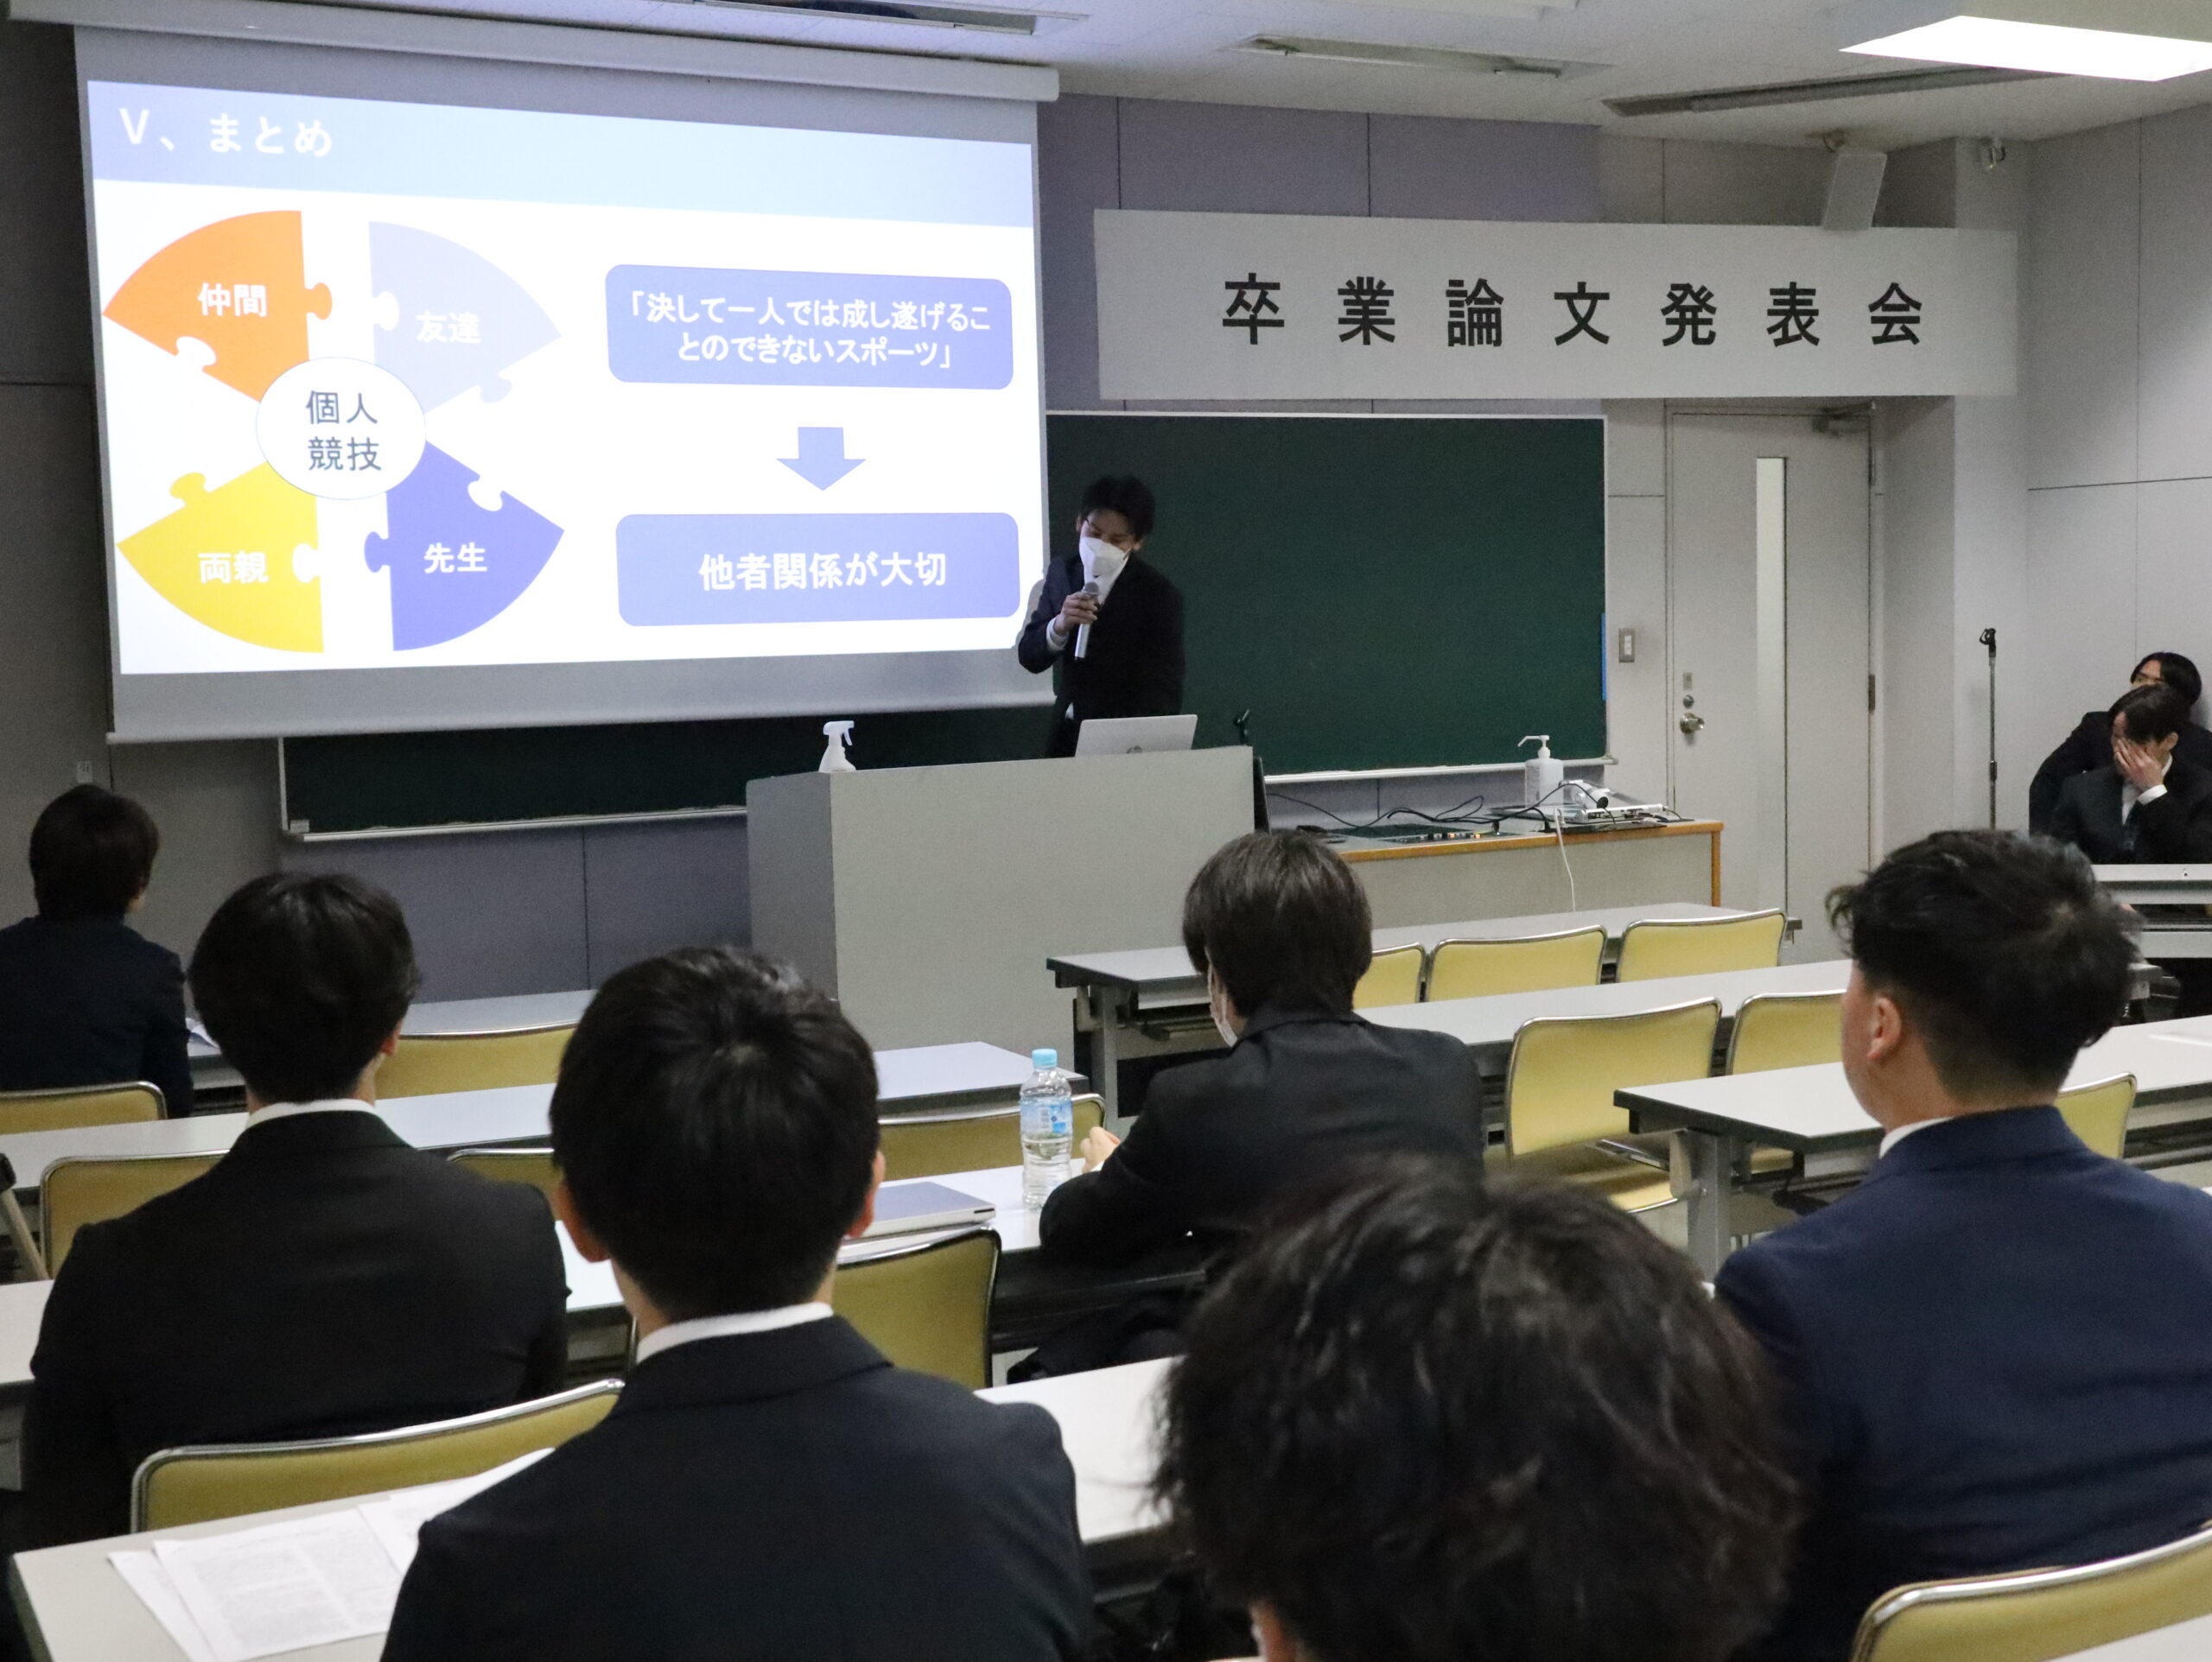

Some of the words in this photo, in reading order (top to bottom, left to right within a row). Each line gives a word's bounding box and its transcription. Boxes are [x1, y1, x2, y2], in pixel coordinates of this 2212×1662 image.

[198, 282, 267, 316] 仲間
[632, 290, 991, 332] 「決して一人では成し遂げるこ
[1222, 272, 1923, 347] 卒業論文発表会
[416, 311, 481, 343] 友達
[677, 333, 950, 369] とのできないスポーツ」
[306, 390, 378, 424] 個人
[308, 436, 382, 471] 競技
[198, 550, 269, 584] 両親
[423, 542, 488, 574] 先生
[698, 552, 947, 591] 他者関係が大切
